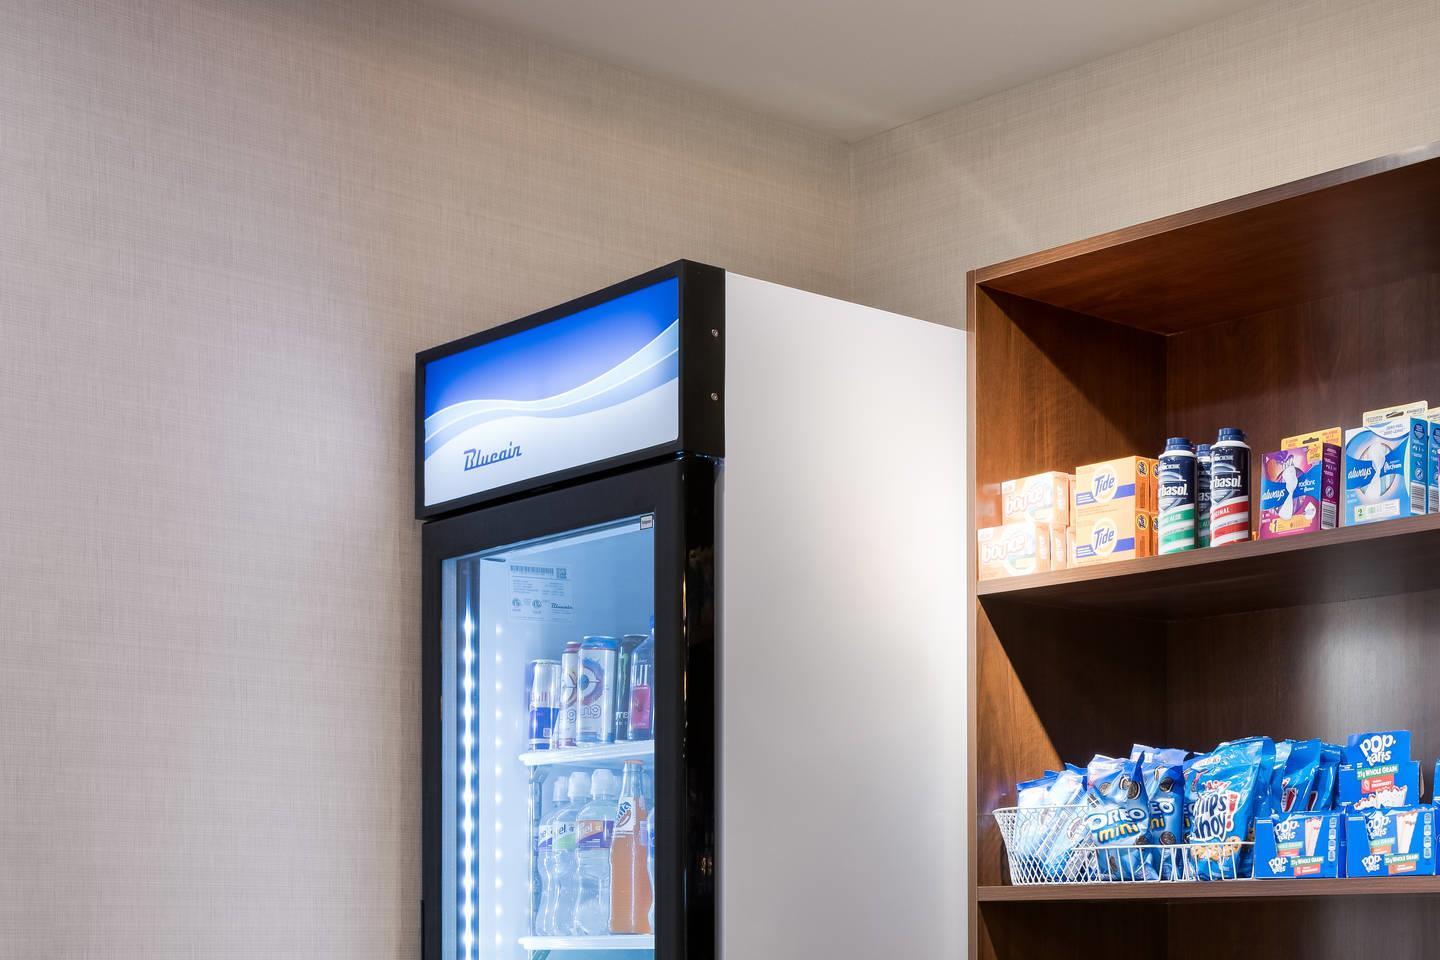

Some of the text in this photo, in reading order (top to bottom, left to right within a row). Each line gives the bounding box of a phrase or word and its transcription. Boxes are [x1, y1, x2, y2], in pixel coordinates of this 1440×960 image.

[464, 441, 522, 471] Blueair
[1348, 467, 1372, 479] always
[1094, 474, 1115, 496] Tide
[1094, 527, 1115, 550] Tide
[1086, 808, 1147, 830] OREO
[1098, 823, 1139, 844] mini
